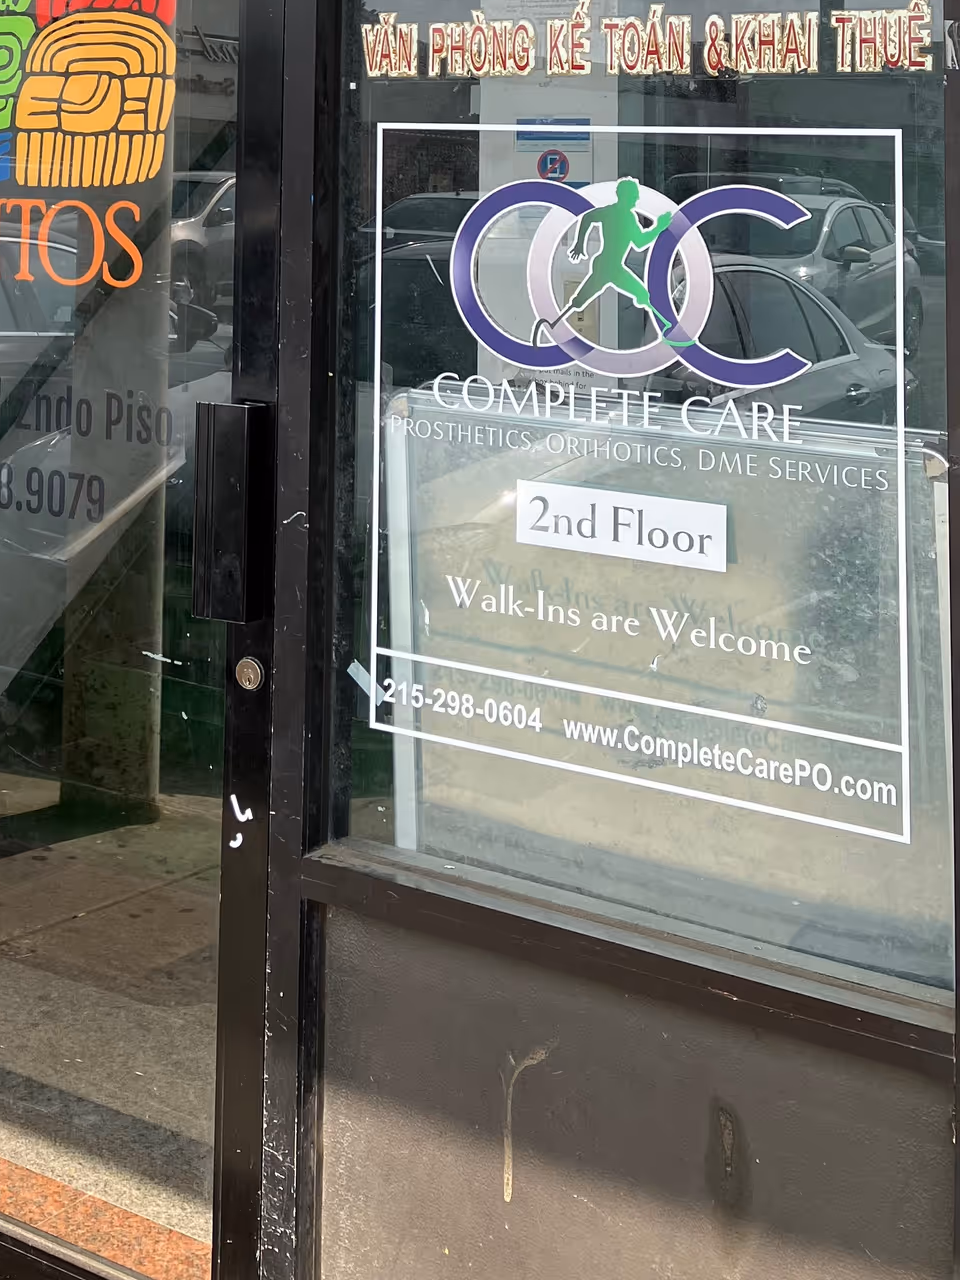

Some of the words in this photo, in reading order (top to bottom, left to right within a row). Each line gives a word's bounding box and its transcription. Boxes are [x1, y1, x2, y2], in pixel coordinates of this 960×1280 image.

[362, 11, 419, 77] VĂN
[429, 9, 537, 77] PHÒNG
[601, 2, 692, 77] TOÁN
[105, 390, 173, 447] Piso
[432, 372, 662, 431] COMPLETE
[681, 396, 804, 446] CARE
[389, 414, 537, 452] PROSTHETICS,
[546, 432, 688, 472] ORTHOTICS,
[698, 449, 759, 477] DME
[768, 456, 890, 492] SERVICES
[529, 495, 598, 540] 2nd
[611, 506, 714, 556] Floor
[446, 575, 582, 628] Walk-Ins
[591, 610, 641, 638] are
[650, 607, 814, 666] Welcome
[383, 677, 543, 733] 215-298-0604
[563, 719, 898, 807] www.CompleteCarePO.com
